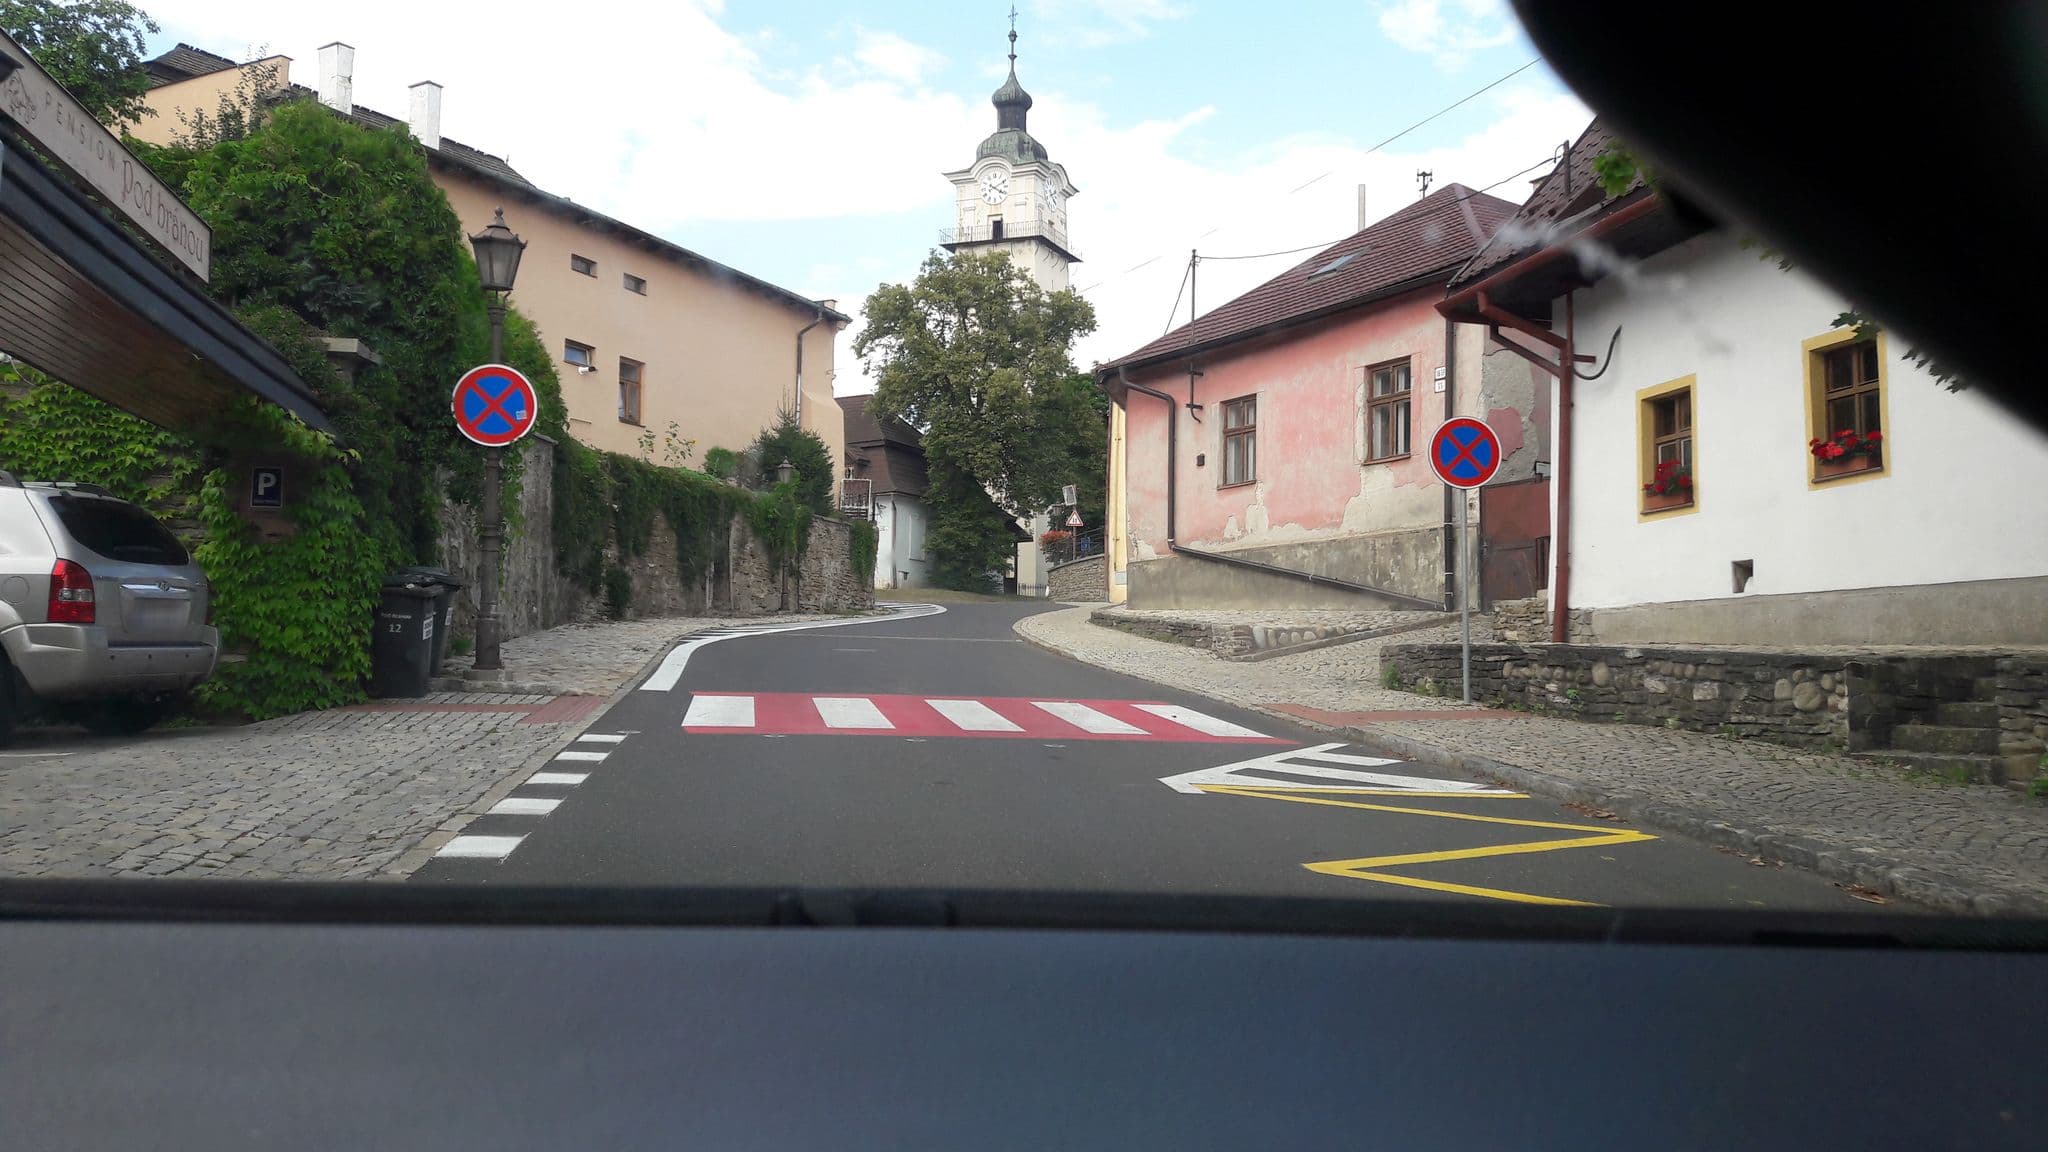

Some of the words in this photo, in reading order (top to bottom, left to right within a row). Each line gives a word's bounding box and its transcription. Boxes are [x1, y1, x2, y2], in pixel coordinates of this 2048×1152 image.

[44, 91, 116, 171] PENSION
[157, 192, 204, 262] bránou
[257, 472, 277, 496] P
[388, 623, 402, 633] 12
